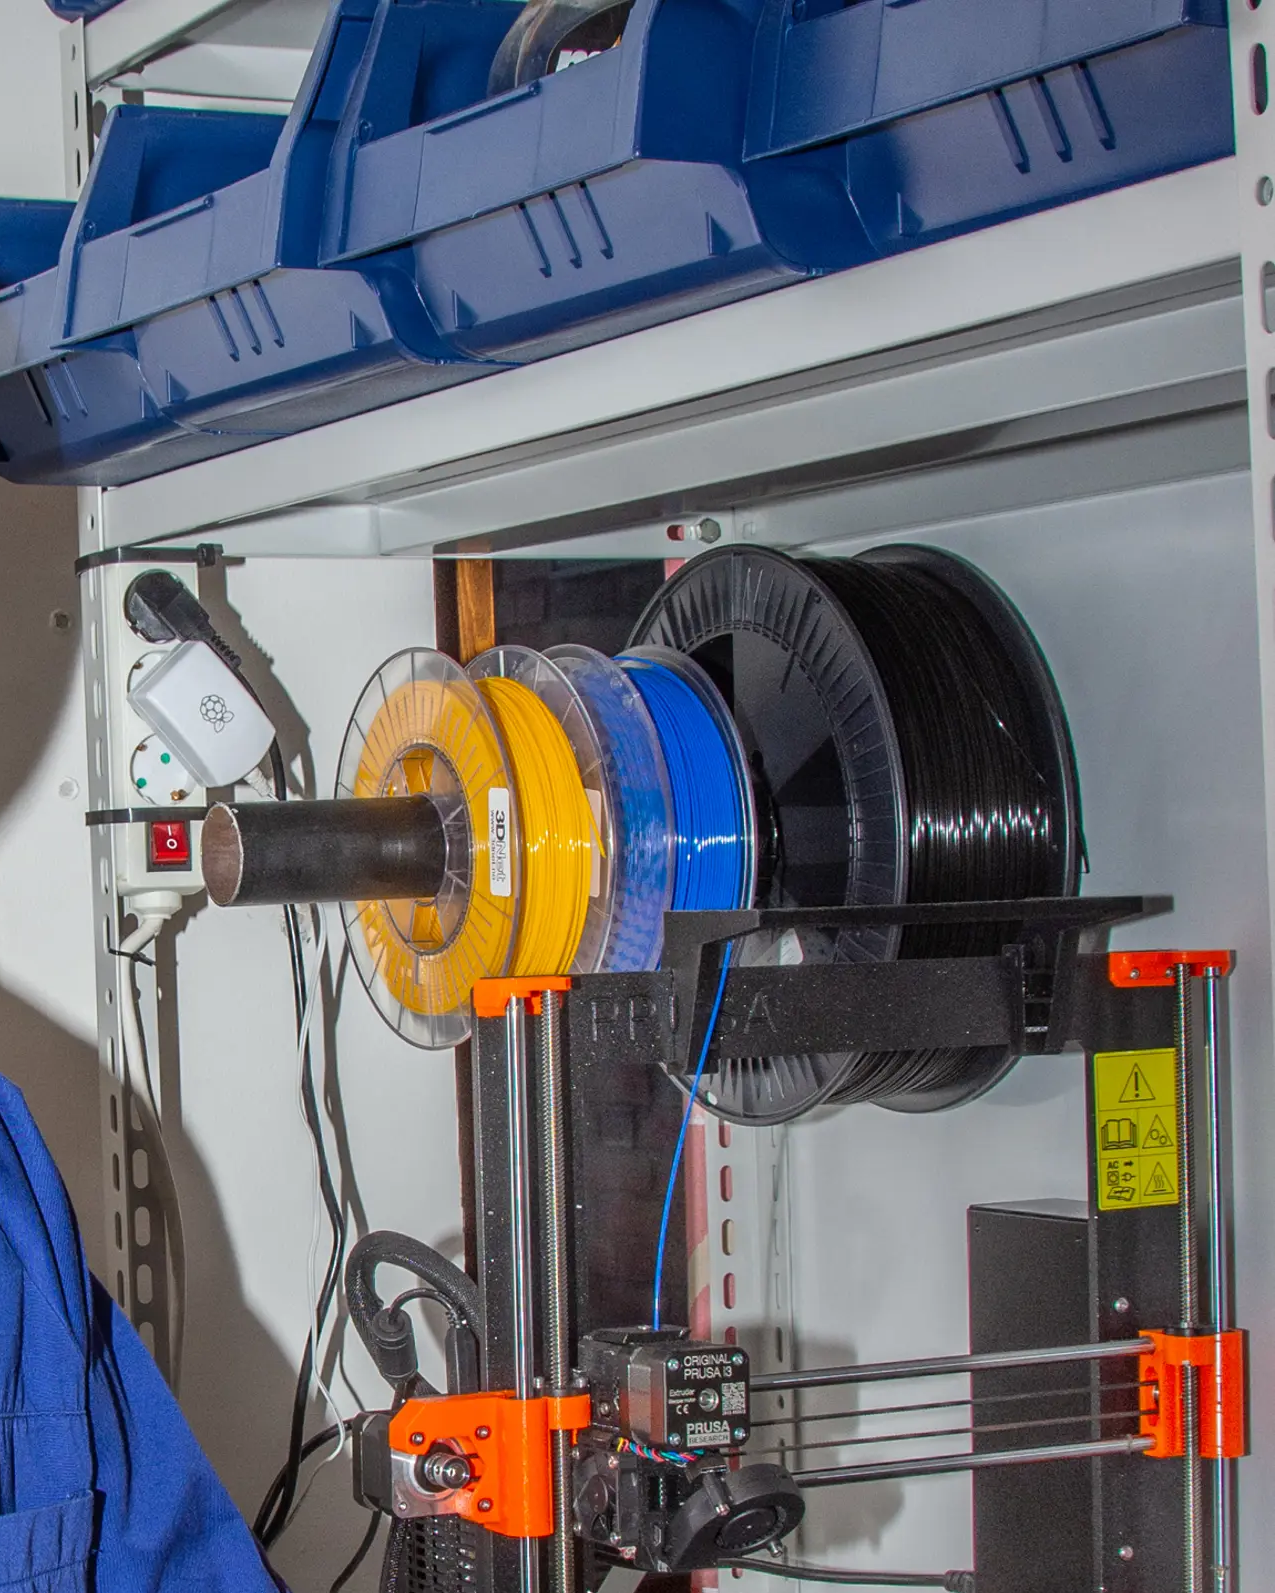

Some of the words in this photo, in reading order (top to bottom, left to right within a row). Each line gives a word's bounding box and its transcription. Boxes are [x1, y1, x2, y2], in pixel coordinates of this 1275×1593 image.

[1107, 1160, 1119, 1170] AC
[683, 1353, 732, 1367] ORIGINAL
[683, 1367, 722, 1381] PRUSA
[686, 1420, 731, 1434] PRUSA
